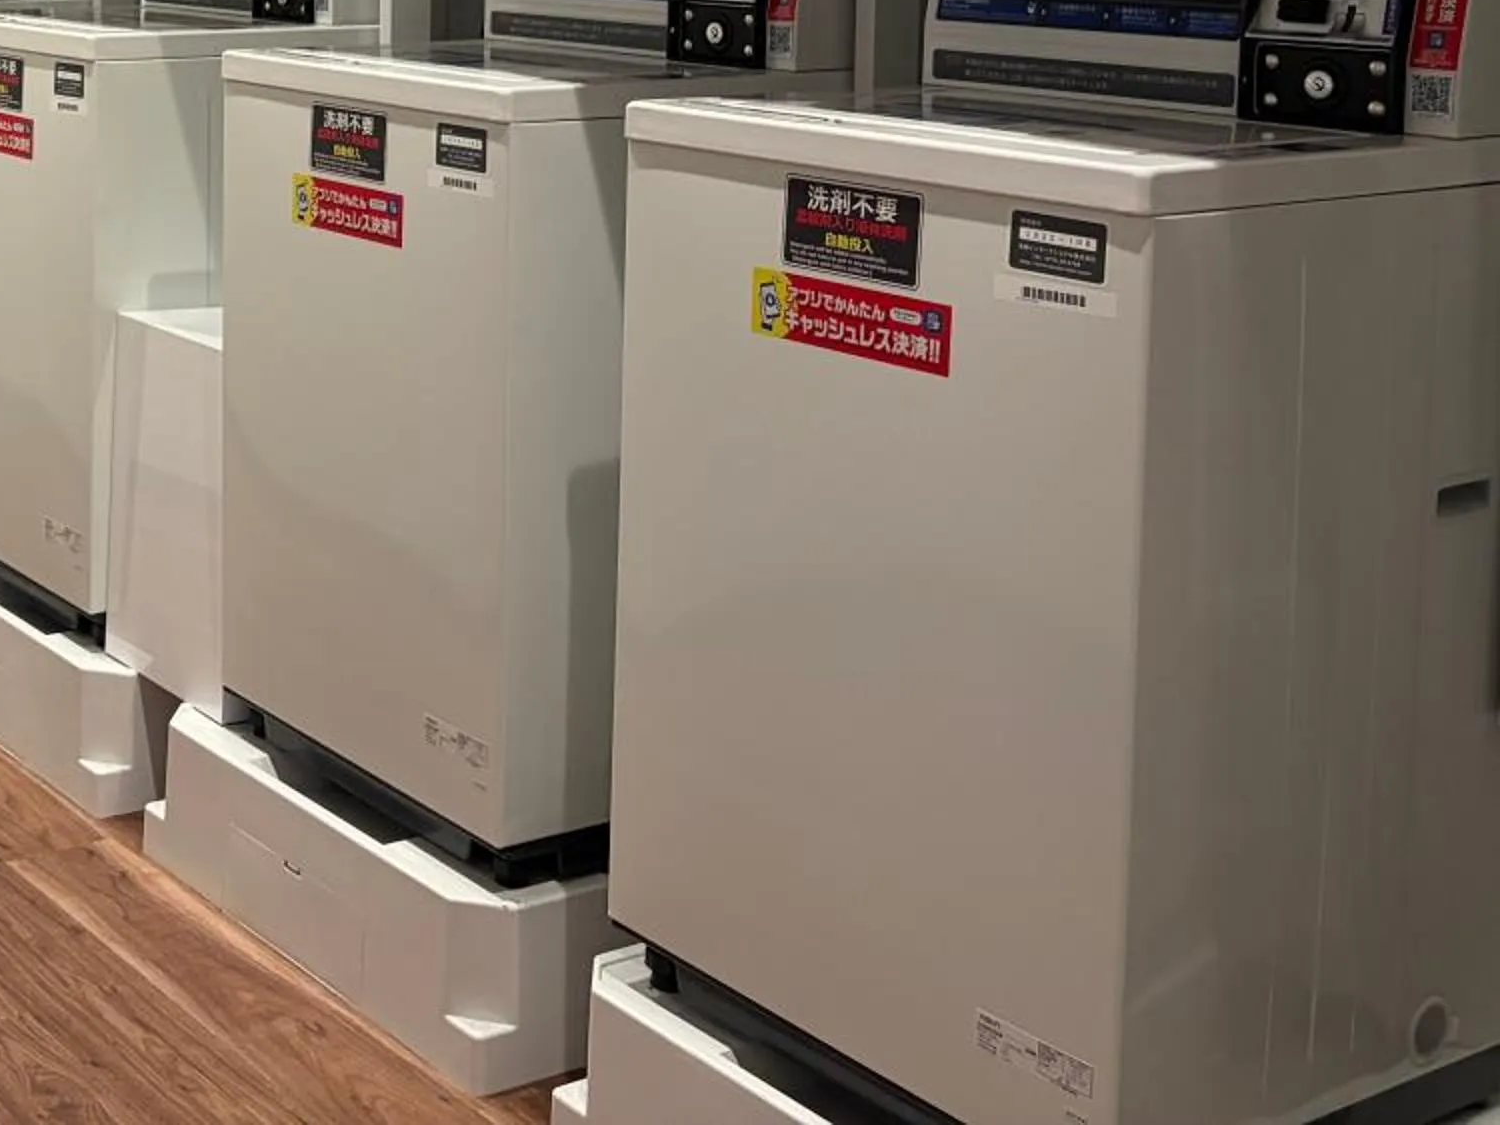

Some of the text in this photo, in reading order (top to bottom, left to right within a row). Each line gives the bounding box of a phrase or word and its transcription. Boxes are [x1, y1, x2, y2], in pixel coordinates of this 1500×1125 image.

[807, 183, 899, 224] 洗剤不要
[787, 286, 886, 322] アプリでかんたん
[785, 309, 941, 363] キャッシュレス決済!!
